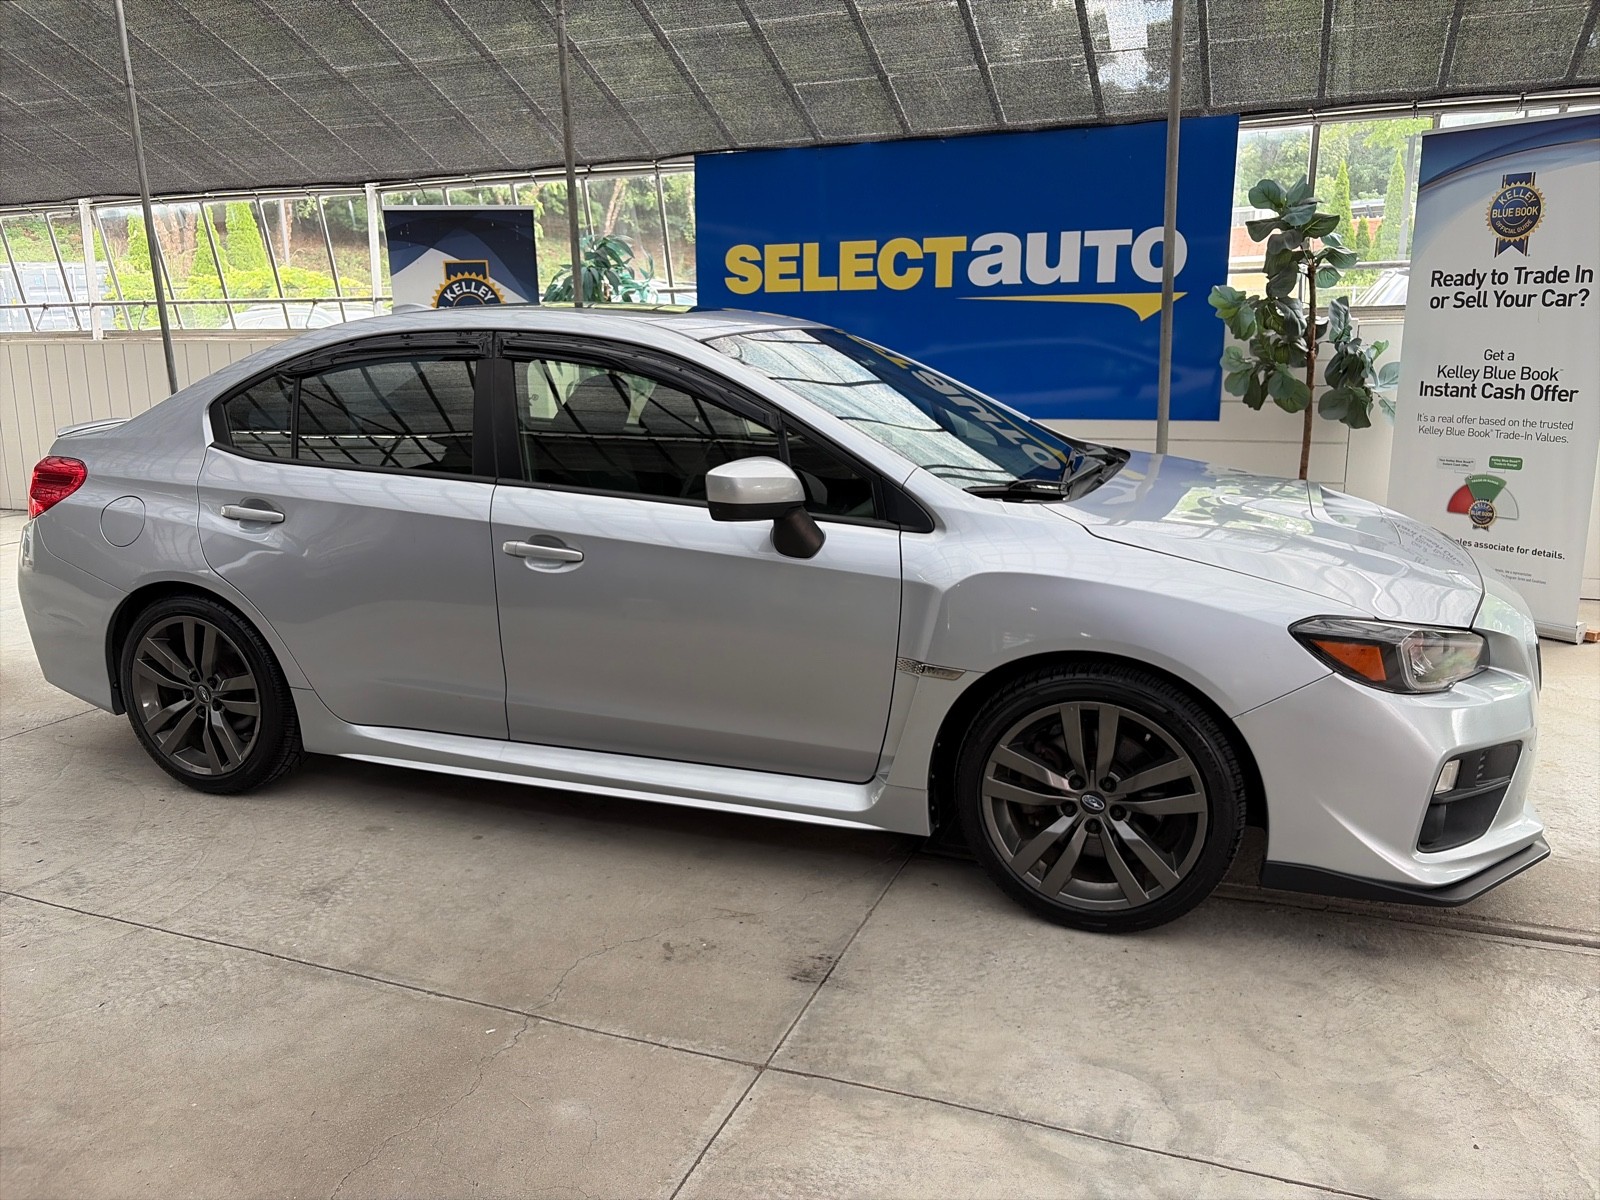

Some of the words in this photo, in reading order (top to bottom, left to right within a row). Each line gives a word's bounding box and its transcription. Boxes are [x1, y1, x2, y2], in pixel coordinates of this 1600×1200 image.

[1498, 189, 1536, 205] KELLEY
[1492, 208, 1514, 218] BLUE
[1515, 206, 1539, 216] BOOK
[1496, 220, 1516, 234] OFFICIAL
[1517, 219, 1532, 232] GUIDE
[1431, 268, 1487, 290] Ready
[1491, 269, 1508, 285] to
[1514, 266, 1570, 284] Trade
[1575, 265, 1593, 283] In
[444, 282, 495, 301] KELLEY
[1430, 296, 1450, 309] or
[1453, 291, 1488, 308] Sell
[1494, 290, 1537, 307] Your
[1542, 288, 1590, 307] Car?
[1484, 349, 1504, 361] Get
[1507, 352, 1515, 361] a
[1437, 365, 1480, 382] Kelley
[1483, 366, 1516, 380] Blue
[1419, 381, 1477, 398] Instant
[1481, 383, 1525, 400] Cash
[1531, 384, 1579, 402] Offer
[1417, 413, 1428, 422] It's
[1438, 414, 1454, 423] real
[1457, 415, 1477, 424] offer
[1479, 416, 1506, 426] based
[1523, 418, 1537, 428] the
[1540, 420, 1573, 430] trusted
[1419, 425, 1444, 437] Kelley
[1446, 427, 1465, 436] Blue
[1495, 429, 1532, 440] Trade-In
[1535, 432, 1568, 443] Values.
[1474, 541, 1514, 552] associate
[1516, 546, 1530, 554] for
[1532, 548, 1565, 560] details.
